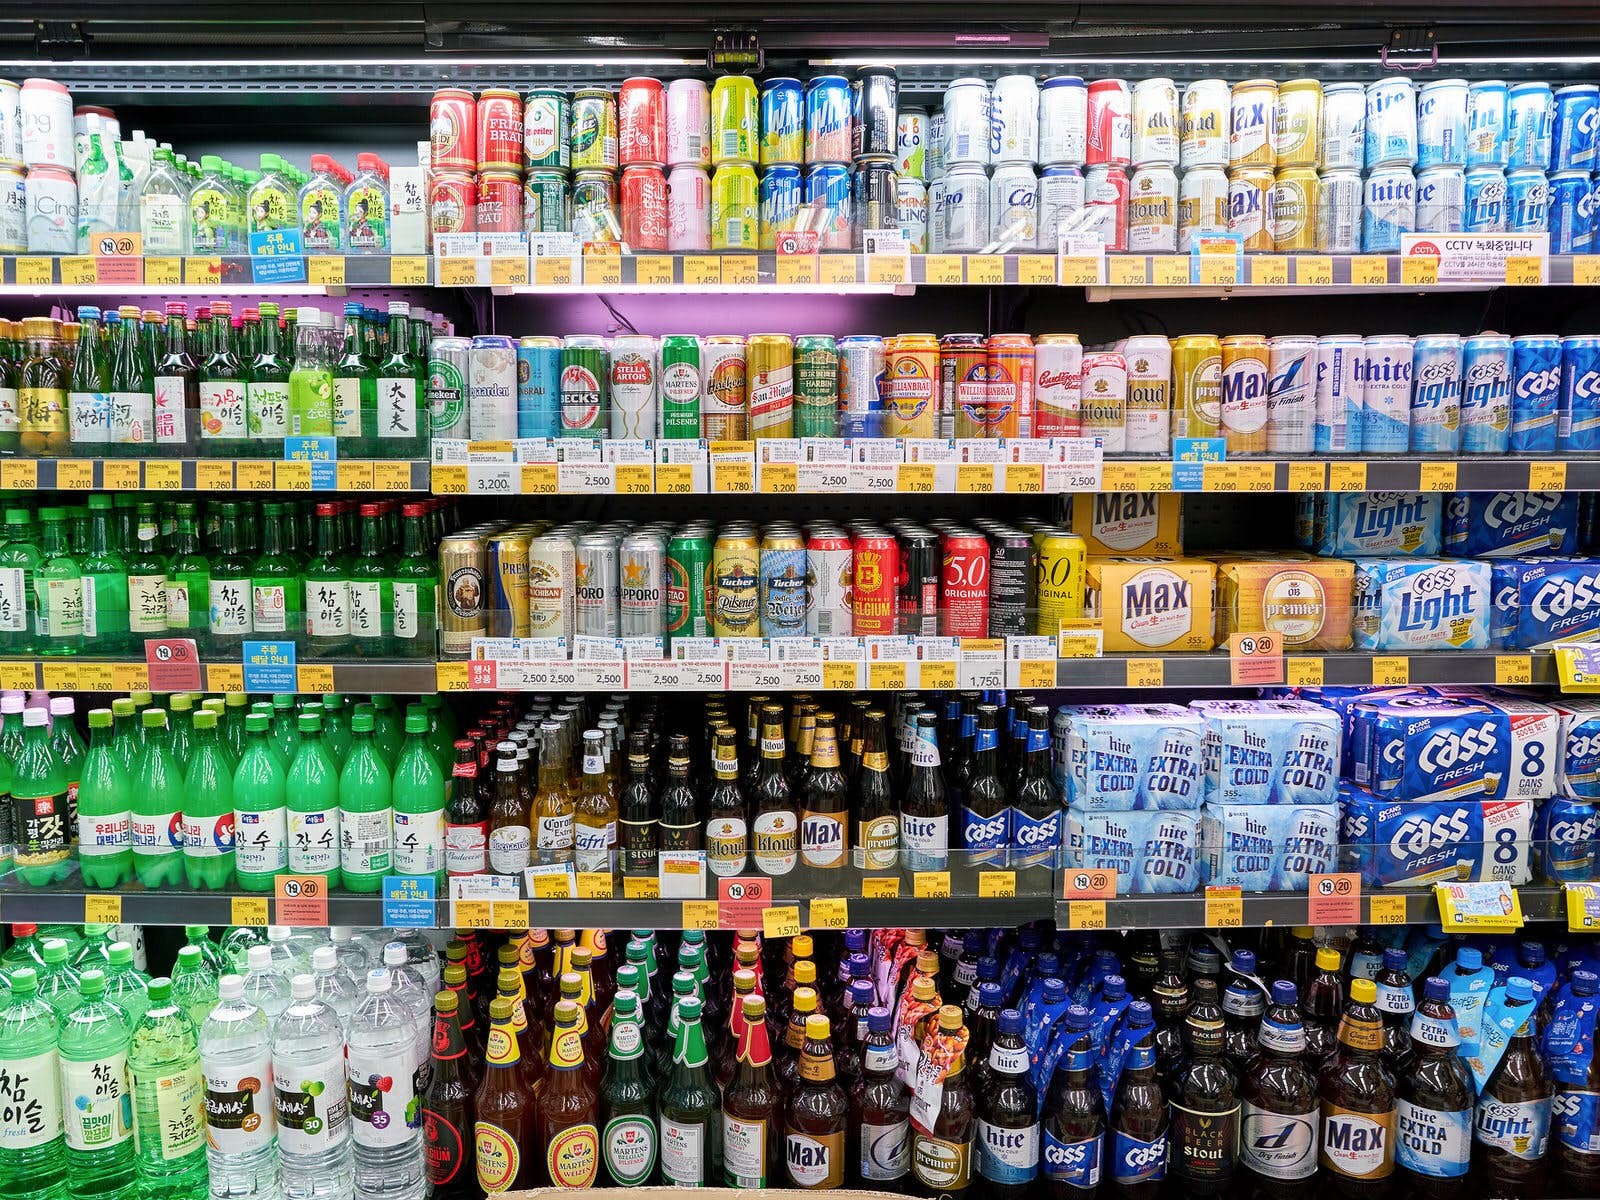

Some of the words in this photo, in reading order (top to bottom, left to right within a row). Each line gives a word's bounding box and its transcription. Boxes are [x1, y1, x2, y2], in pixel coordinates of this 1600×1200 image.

[489, 116, 523, 130] FRITZ
[404, 179, 418, 196] 참
[1371, 178, 1413, 203] hite
[406, 195, 423, 211] 이슬
[1414, 246, 1435, 255] CCTV
[1445, 240, 1473, 251] CCTV
[1475, 239, 1533, 252] 녹화중입니다
[616, 366, 647, 377] STELLA
[1366, 357, 1412, 383] hite
[616, 375, 648, 386] ARTOIS
[665, 380, 698, 392] MARTENS
[805, 380, 833, 388] HARBIN
[1224, 370, 1272, 403] Max
[76, 406, 106, 428] 청하
[220, 405, 243, 426] 이슬
[261, 404, 286, 426] 이슬
[665, 418, 699, 427] PILSENER
[476, 477, 507, 490] 3,200
[584, 474, 610, 487] 2,500
[821, 474, 847, 486] 2,500
[867, 476, 894, 488] 2,500
[1069, 475, 1096, 487] 2,500
[1354, 496, 1430, 538] Light
[1502, 515, 1550, 539] FRESH
[1153, 542, 1170, 550] 355
[948, 555, 987, 587] 5,0
[720, 578, 754, 587] Tucher
[773, 579, 805, 588] Tucher
[1412, 568, 1456, 595] Cass
[222, 585, 240, 606] 참
[319, 586, 336, 608] 참
[945, 589, 988, 598] ORIGINAL
[1125, 579, 1188, 620] Max
[718, 595, 757, 616] Pilsener
[1266, 601, 1323, 619] premier
[1398, 584, 1478, 632] Light
[224, 604, 246, 626] 이슬
[320, 607, 344, 629] 이슬
[1550, 608, 1600, 633] FRESH
[857, 621, 882, 629] EXPORT
[1187, 636, 1208, 645] 355
[261, 645, 278, 655] 주류
[522, 672, 547, 684] 2,500
[549, 673, 574, 685] 2,500
[596, 673, 621, 685] 2,500
[653, 674, 678, 686] 2,500
[697, 672, 722, 684] 2,500
[754, 674, 779, 686] 2,500
[969, 675, 1000, 688] 1,750
[1407, 724, 1415, 736] 8
[1414, 718, 1431, 731] CANS
[1109, 736, 1131, 755] hite
[1164, 739, 1194, 757] hite
[1244, 731, 1267, 749] hite
[1299, 733, 1329, 751] hite
[1418, 720, 1498, 776] Cass
[1088, 750, 1138, 774] EXTRA
[1225, 743, 1273, 768] EXTRA
[1282, 750, 1334, 776] EXTRA
[1514, 740, 1543, 778] 8
[1148, 756, 1198, 781] EXTRA
[1233, 766, 1270, 787] COLD
[1432, 751, 1485, 785] FRESH
[1100, 772, 1135, 793] COLD
[1148, 774, 1191, 797] COLD
[1282, 769, 1327, 792] COLD
[1518, 778, 1543, 789] CANS
[1089, 796, 1105, 805] 355
[1224, 790, 1239, 798] 355
[803, 819, 841, 845] Max
[904, 817, 935, 839] hite
[966, 817, 1005, 845] Cass
[1017, 817, 1056, 846] Cass
[1159, 824, 1189, 841] hite
[1390, 807, 1471, 861] Cass
[1144, 840, 1193, 865] EXTRA
[1488, 828, 1519, 865] 8
[1404, 842, 1457, 872] FRESH
[1143, 858, 1187, 881] COLD
[1492, 865, 1517, 876] CANS
[400, 879, 418, 890] 주류
[1385, 993, 1411, 1003] EXTRA
[1387, 1000, 1410, 1010] COLD
[1420, 1024, 1449, 1036] EXTRA
[1422, 1033, 1447, 1044] COLD
[998, 1055, 1019, 1068] hite
[91, 1062, 110, 1081] 참
[0, 1068, 30, 1103] 참
[95, 1079, 121, 1099] 이슬
[2, 1099, 46, 1134] 이슬
[1409, 1105, 1437, 1124] hite
[1486, 1102, 1520, 1118] Cass
[245, 1115, 259, 1128] 25
[305, 1119, 320, 1131] 30
[372, 1114, 388, 1126] 35
[1400, 1114, 1449, 1141] EXTRA
[1476, 1107, 1533, 1140] Light
[3, 1127, 27, 1138] fresh
[986, 1125, 1025, 1148] hite
[1185, 1127, 1224, 1138] BLACK
[1326, 1121, 1383, 1151] Max
[613, 1145, 649, 1157] MARTENS
[1403, 1133, 1442, 1156] COLD
[559, 1156, 594, 1172] MARTENS
[917, 1150, 958, 1170] premier
[1124, 1143, 1164, 1168] Cass
[1257, 1150, 1271, 1162] Dry
[1272, 1150, 1297, 1160] Finish
[562, 1166, 591, 1180] WEIZEN
